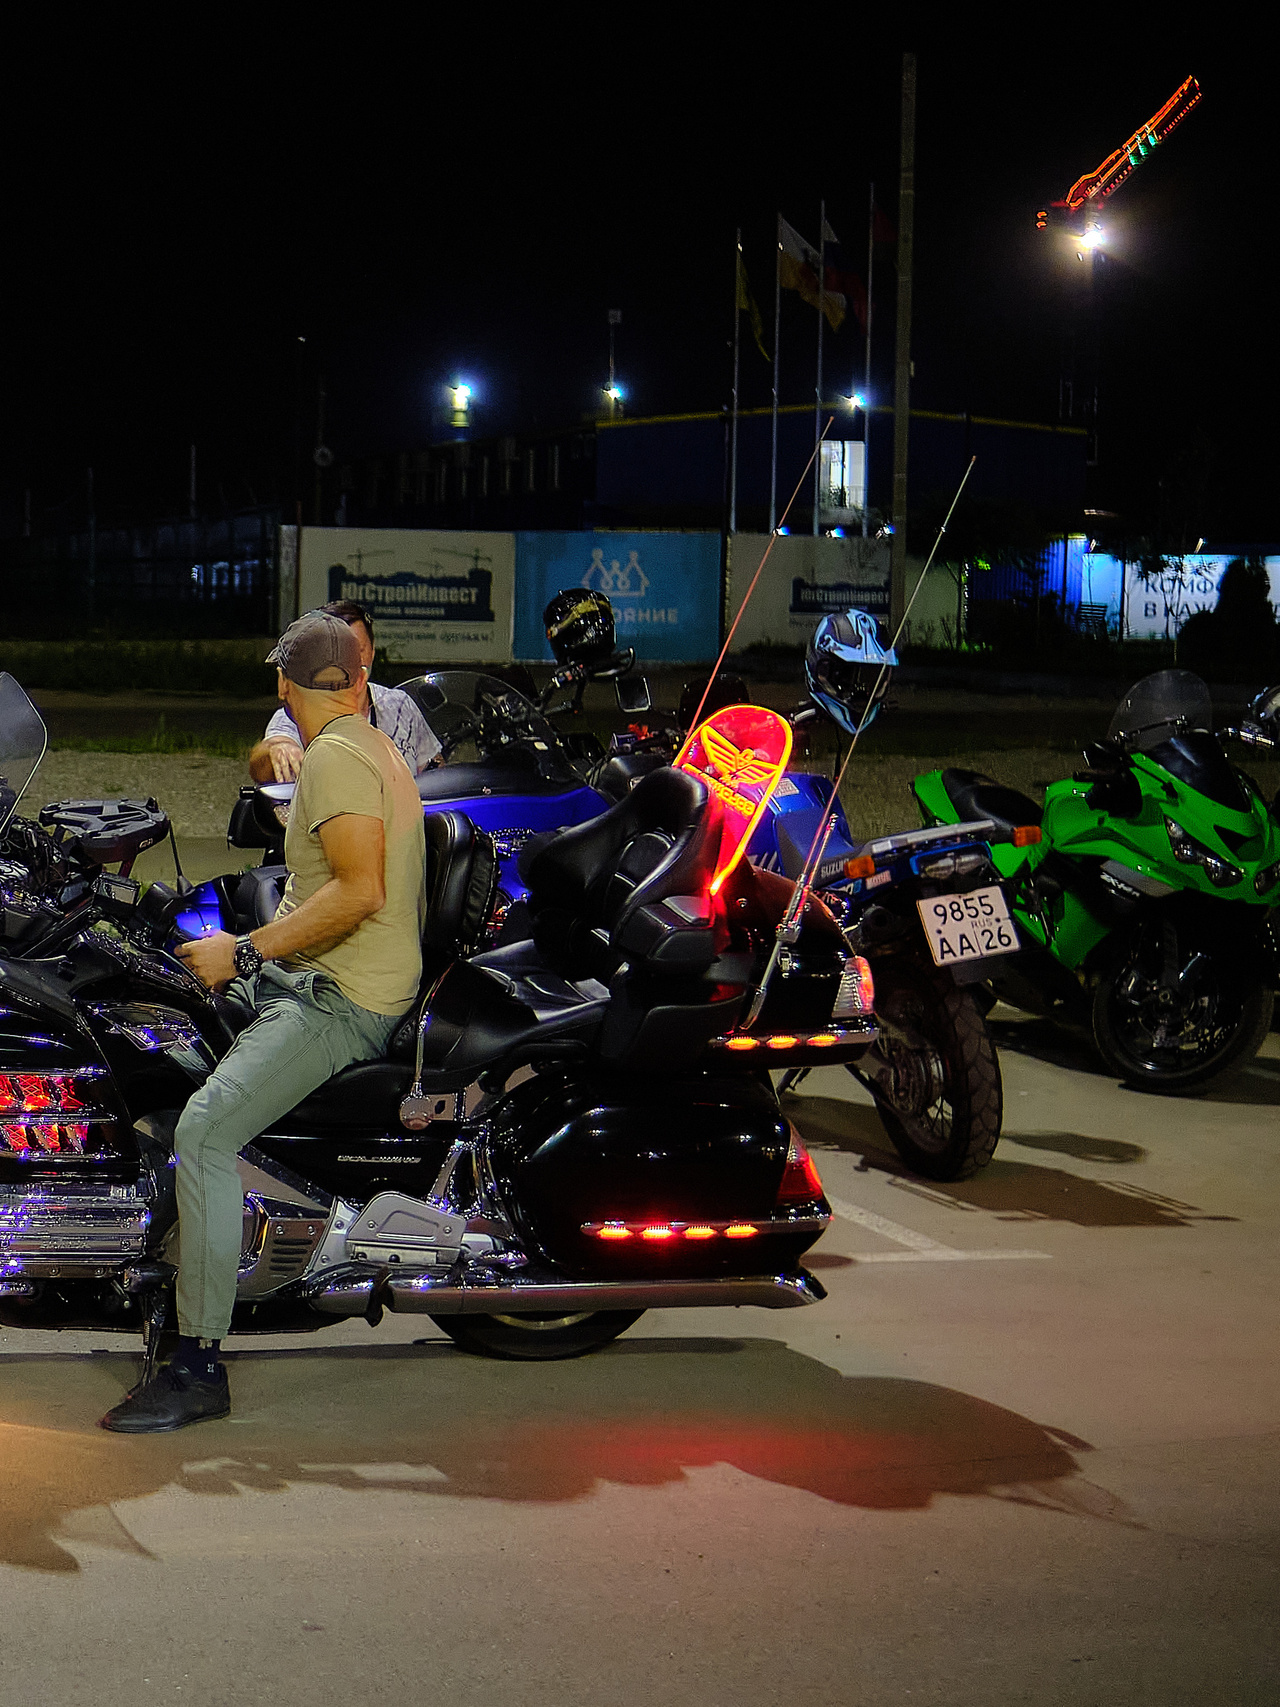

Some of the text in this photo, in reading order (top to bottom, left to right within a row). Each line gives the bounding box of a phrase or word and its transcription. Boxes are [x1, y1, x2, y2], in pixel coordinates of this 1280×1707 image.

[1144, 577, 1221, 595] КОМФ
[933, 894, 994, 925] 9855
[971, 918, 993, 929] RUS
[981, 926, 1012, 950] 26
